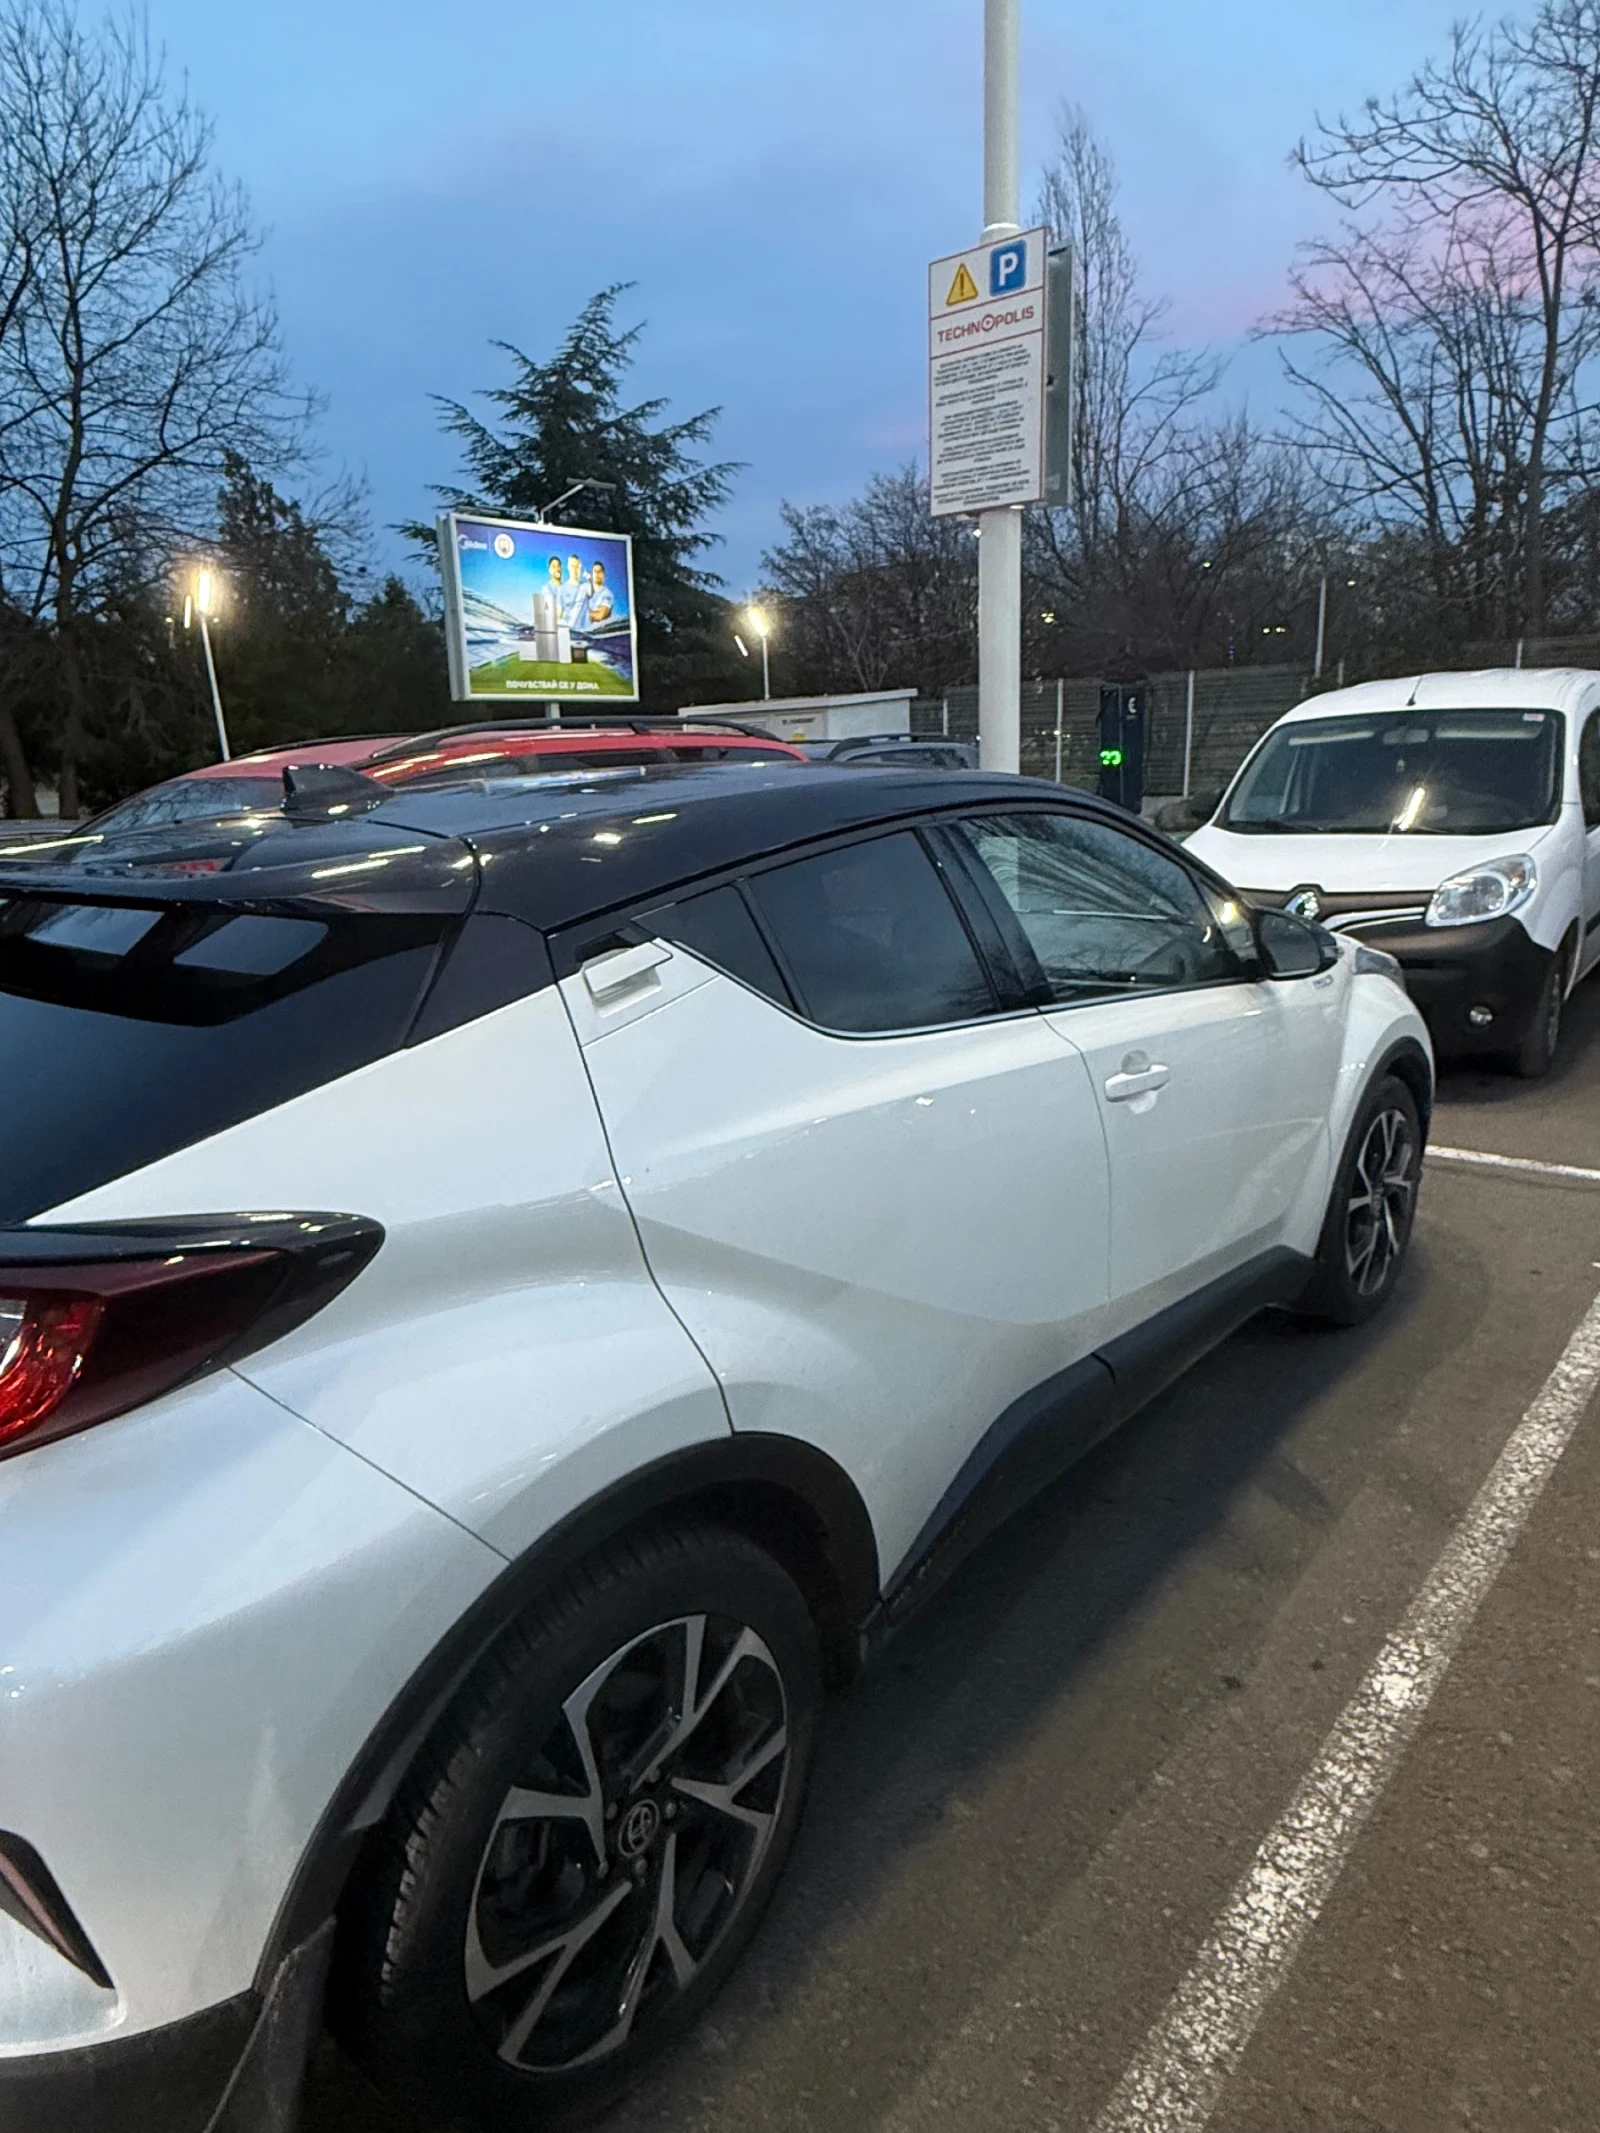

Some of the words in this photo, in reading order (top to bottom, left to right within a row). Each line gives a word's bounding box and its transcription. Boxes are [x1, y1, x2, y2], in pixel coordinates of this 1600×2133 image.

[998, 252, 1018, 287] P
[937, 305, 1035, 343] TECHNOPOLIS
[506, 679, 557, 689] ПОЧУВСТВАЙ
